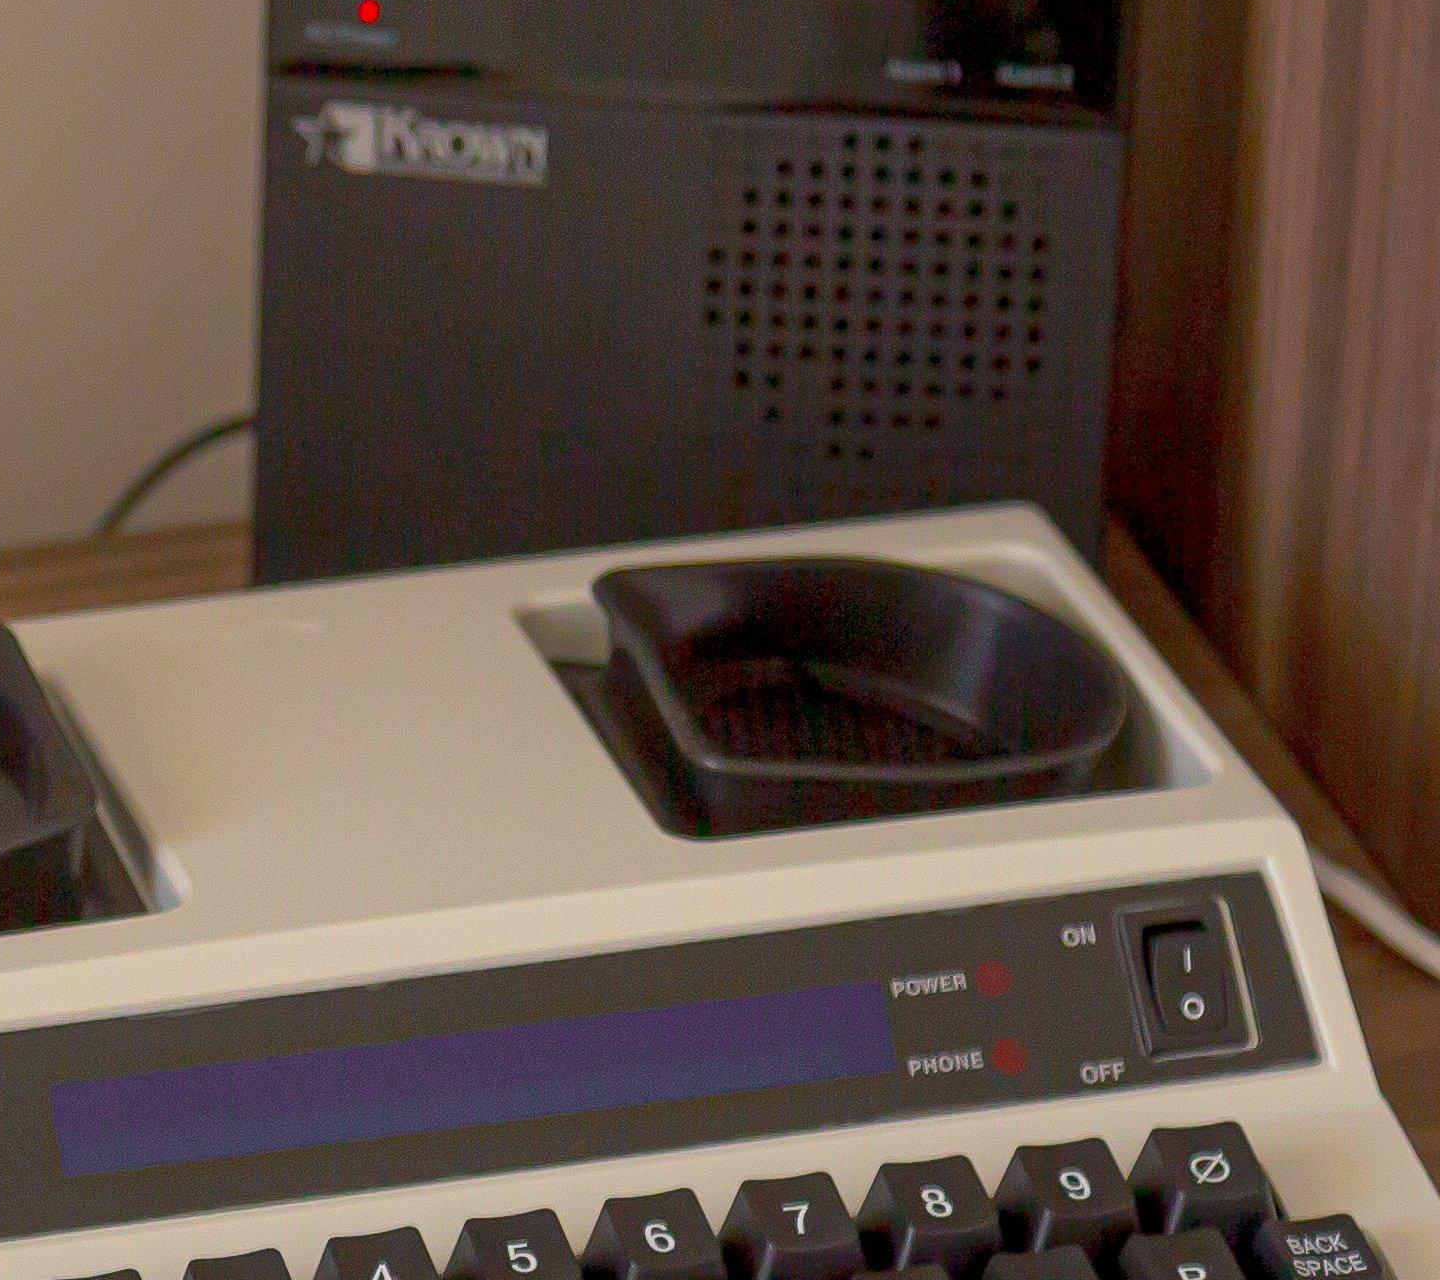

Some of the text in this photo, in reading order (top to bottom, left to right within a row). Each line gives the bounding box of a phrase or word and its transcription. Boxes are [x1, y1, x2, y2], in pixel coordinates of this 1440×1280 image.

[1061, 925, 1097, 950] ON
[891, 972, 967, 998] POWER
[907, 1050, 984, 1077] PHONE
[1080, 1059, 1125, 1084] OFF
[1059, 1171, 1091, 1200] 9
[921, 1188, 953, 1218] 8
[782, 1202, 809, 1235] 7
[644, 1223, 675, 1253] 6
[1286, 1230, 1347, 1254] BACK
[507, 1242, 538, 1273] 5
[1293, 1253, 1367, 1278] SPACE
